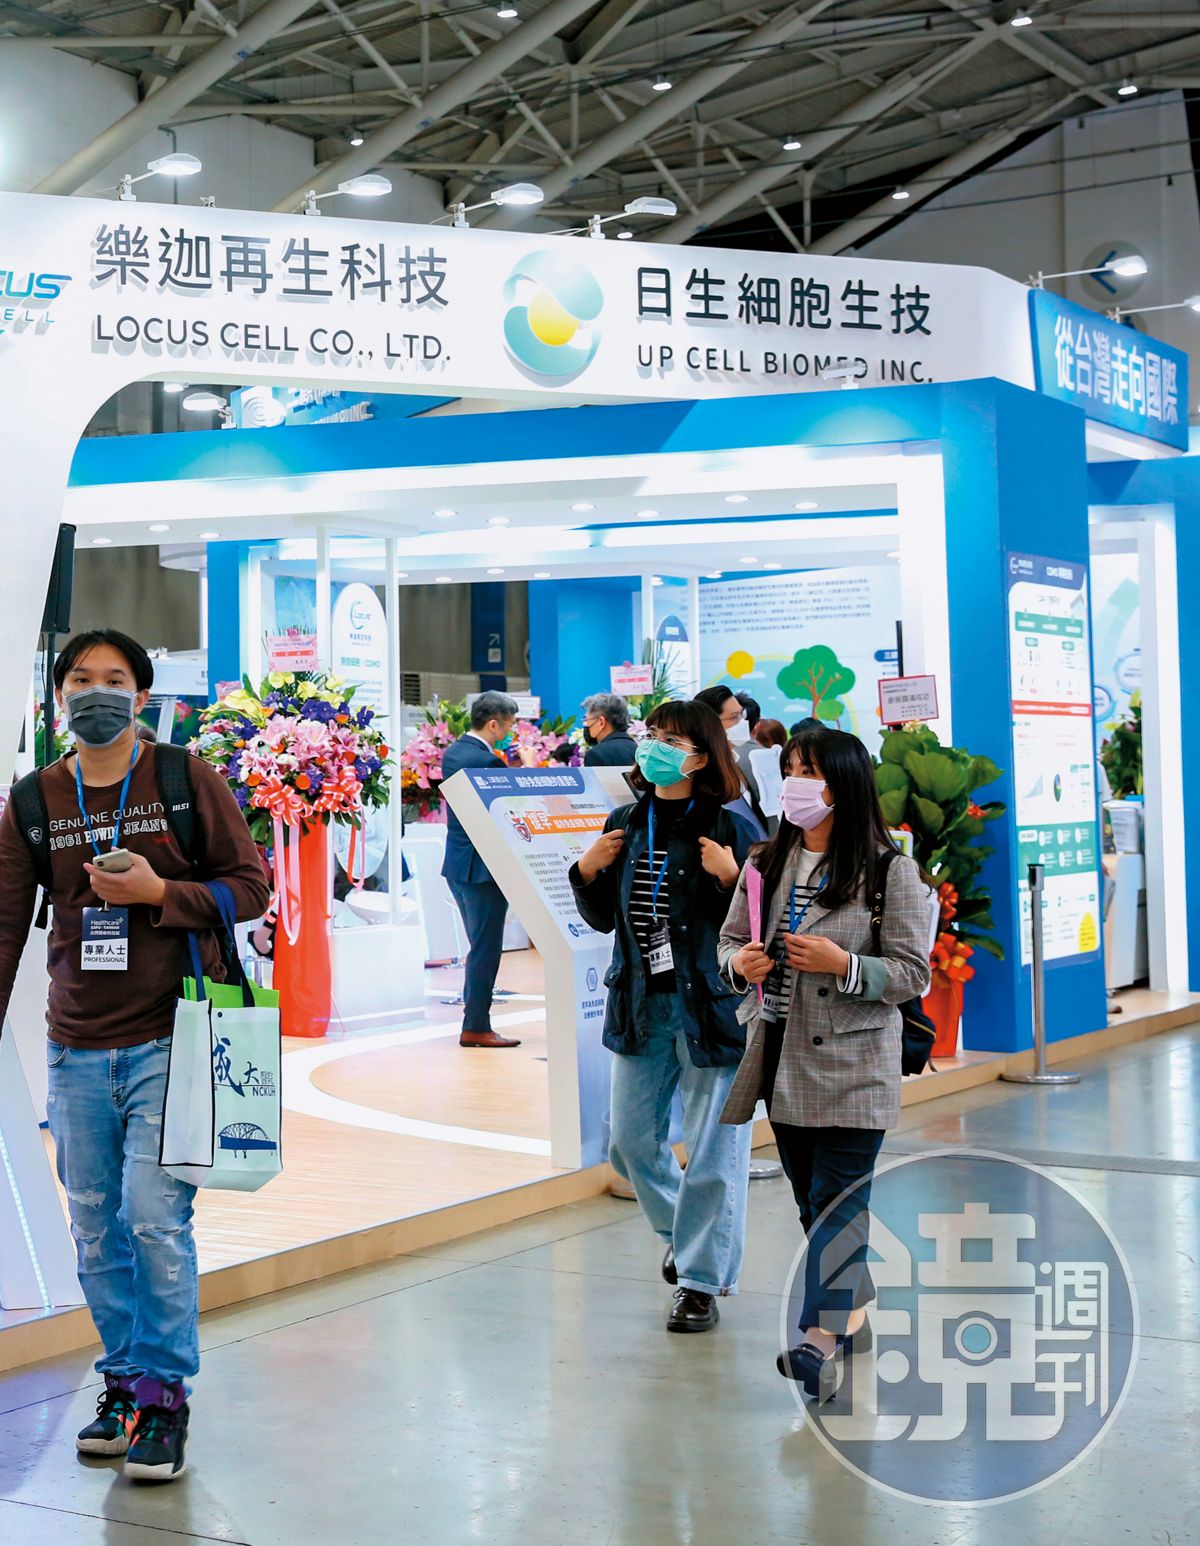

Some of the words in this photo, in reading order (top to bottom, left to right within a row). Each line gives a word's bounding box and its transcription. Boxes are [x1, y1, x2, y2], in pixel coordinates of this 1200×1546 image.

[95, 223, 450, 306] 樂迦再生科技
[637, 266, 933, 336] 日生細胞生技
[97, 314, 210, 347] LOCUS
[220, 322, 299, 352] CELL
[310, 328, 374, 359] CO.,
[385, 333, 452, 361] LTD.
[638, 345, 674, 368] UP
[687, 347, 751, 372] CELL
[881, 359, 933, 383] INC.
[1054, 315, 1178, 425] 從台灣走向國際
[84, 944, 126, 955] 專業人士
